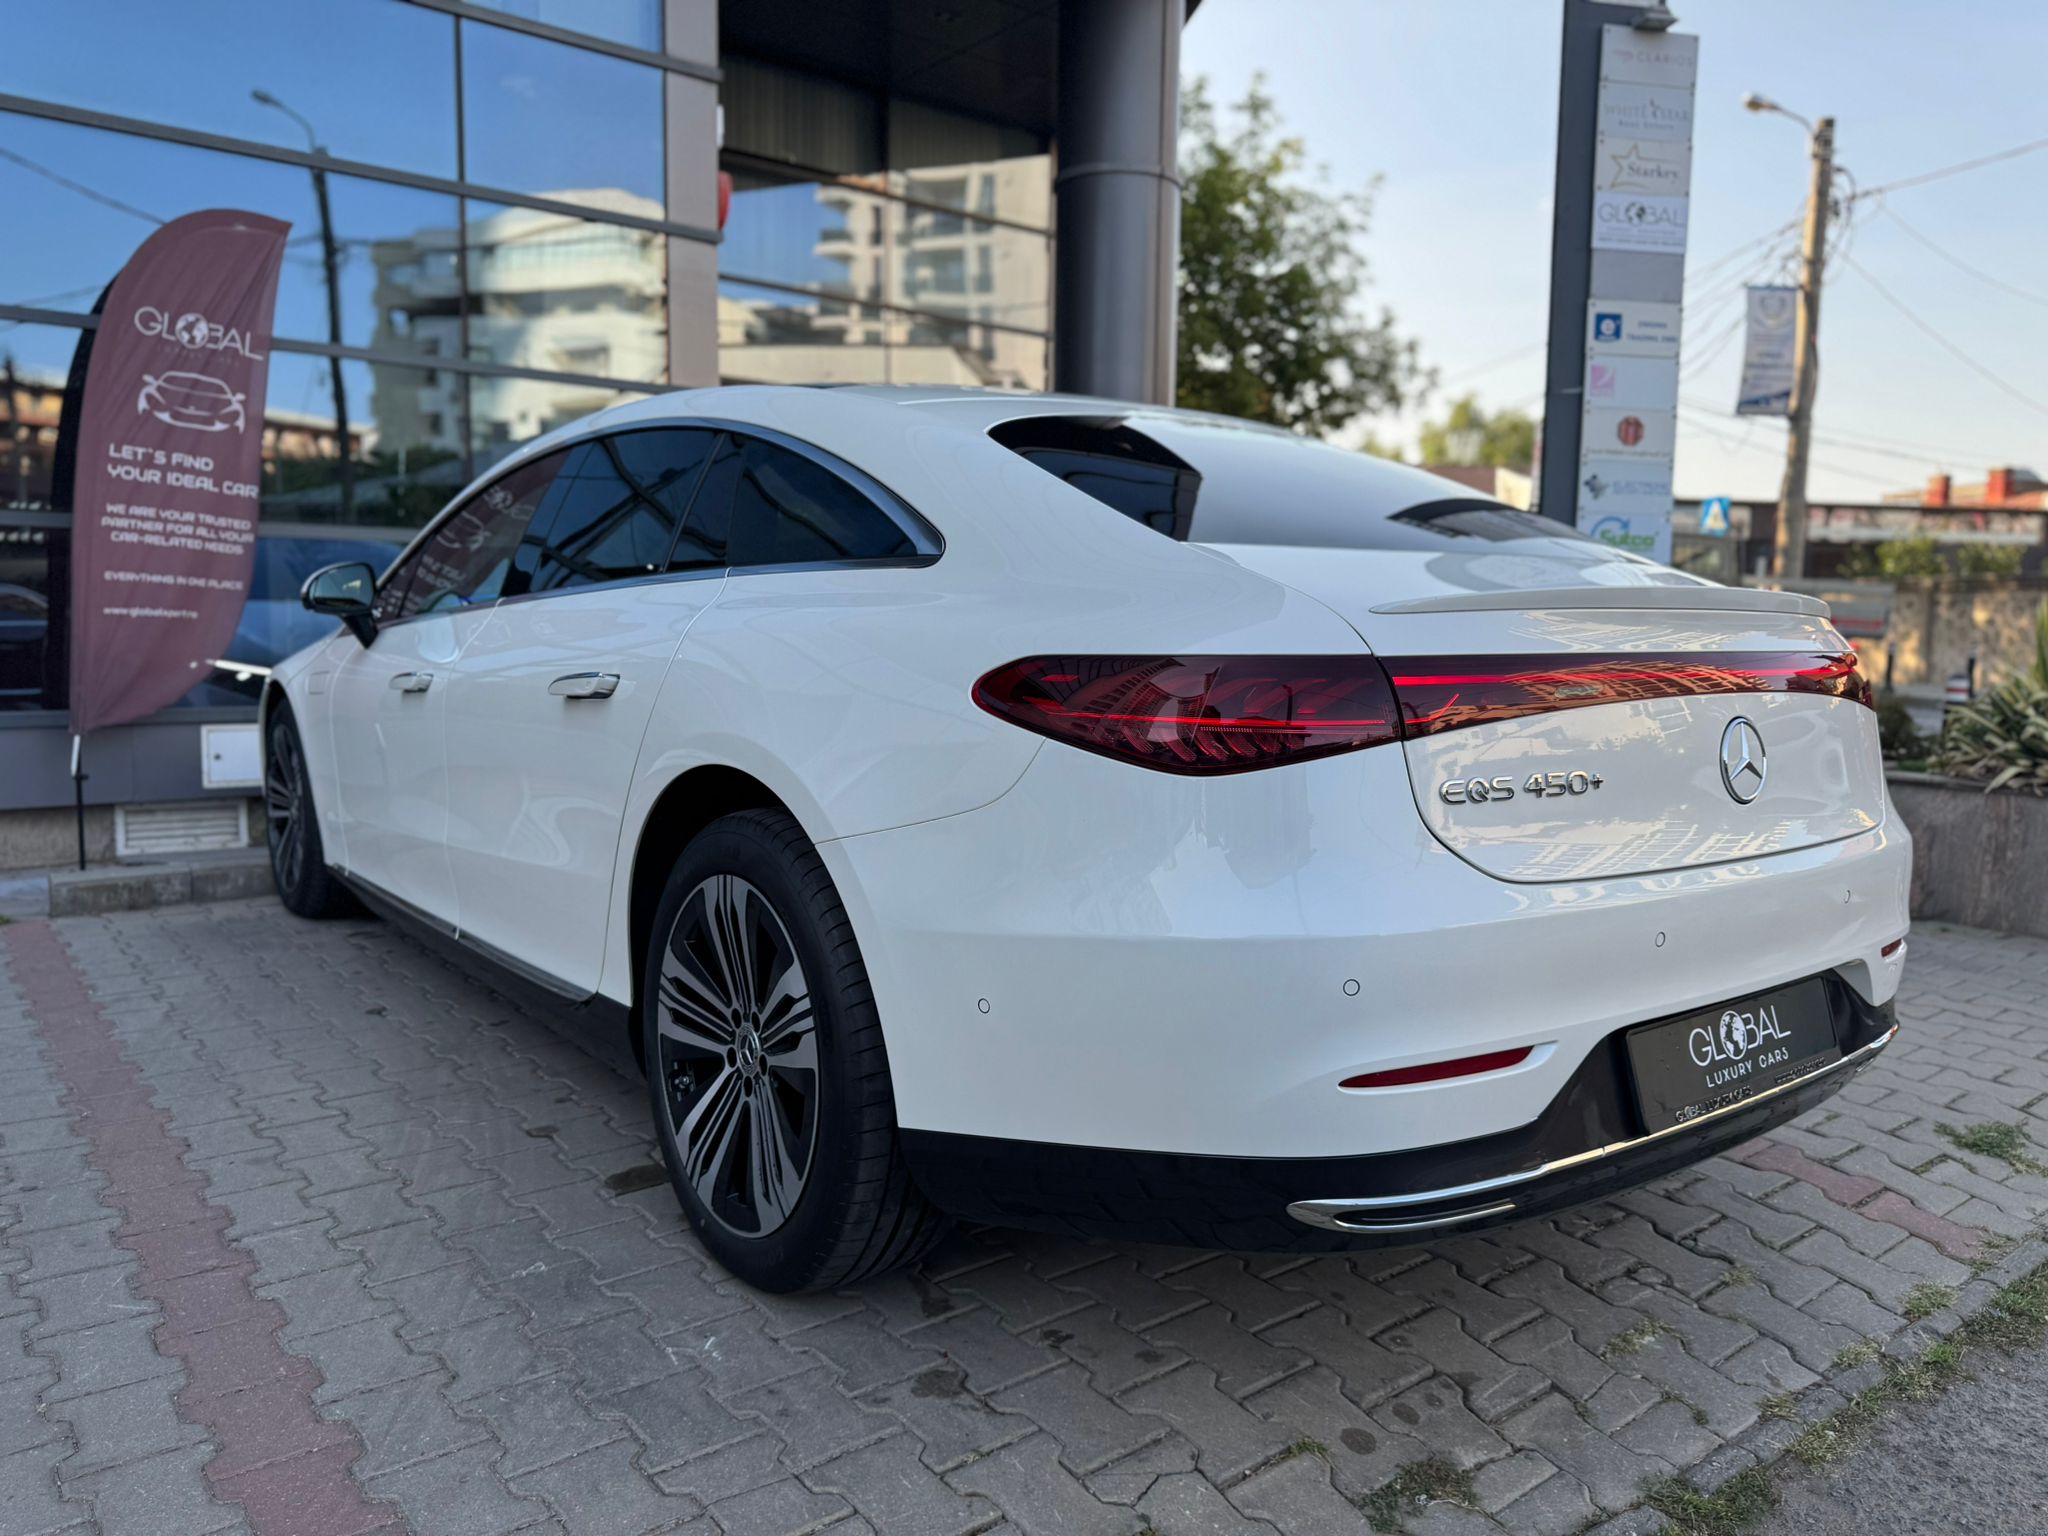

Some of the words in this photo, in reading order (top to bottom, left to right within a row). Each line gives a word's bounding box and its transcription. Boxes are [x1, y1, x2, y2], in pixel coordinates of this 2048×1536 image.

[1626, 162, 1679, 184] Starkey
[133, 306, 264, 361] GLOBAL
[109, 443, 167, 465] LET'S
[171, 452, 214, 471] FIND
[107, 463, 161, 484] YOUR
[166, 471, 220, 493] IDEAL
[222, 481, 259, 499] CAR
[101, 516, 165, 532] PARTNER
[166, 522, 194, 536] FOR
[196, 526, 217, 539] ALL
[219, 530, 255, 544] YOUR
[106, 502, 126, 515] WE
[128, 504, 157, 517] ARE
[159, 508, 196, 522] YOUR
[198, 512, 252, 531] TRUSTED
[110, 530, 203, 550] CAR-RELATED
[204, 540, 245, 556] NEEDS
[104, 570, 175, 585] EVERYTHING
[207, 578, 244, 591] PLACE
[1439, 776, 1515, 805] EQS
[1523, 770, 1604, 798] 450+
[1689, 1005, 1791, 1067] GLOBAL
[1705, 1060, 1752, 1088] LUXURY
[1758, 1047, 1789, 1068] CARS
